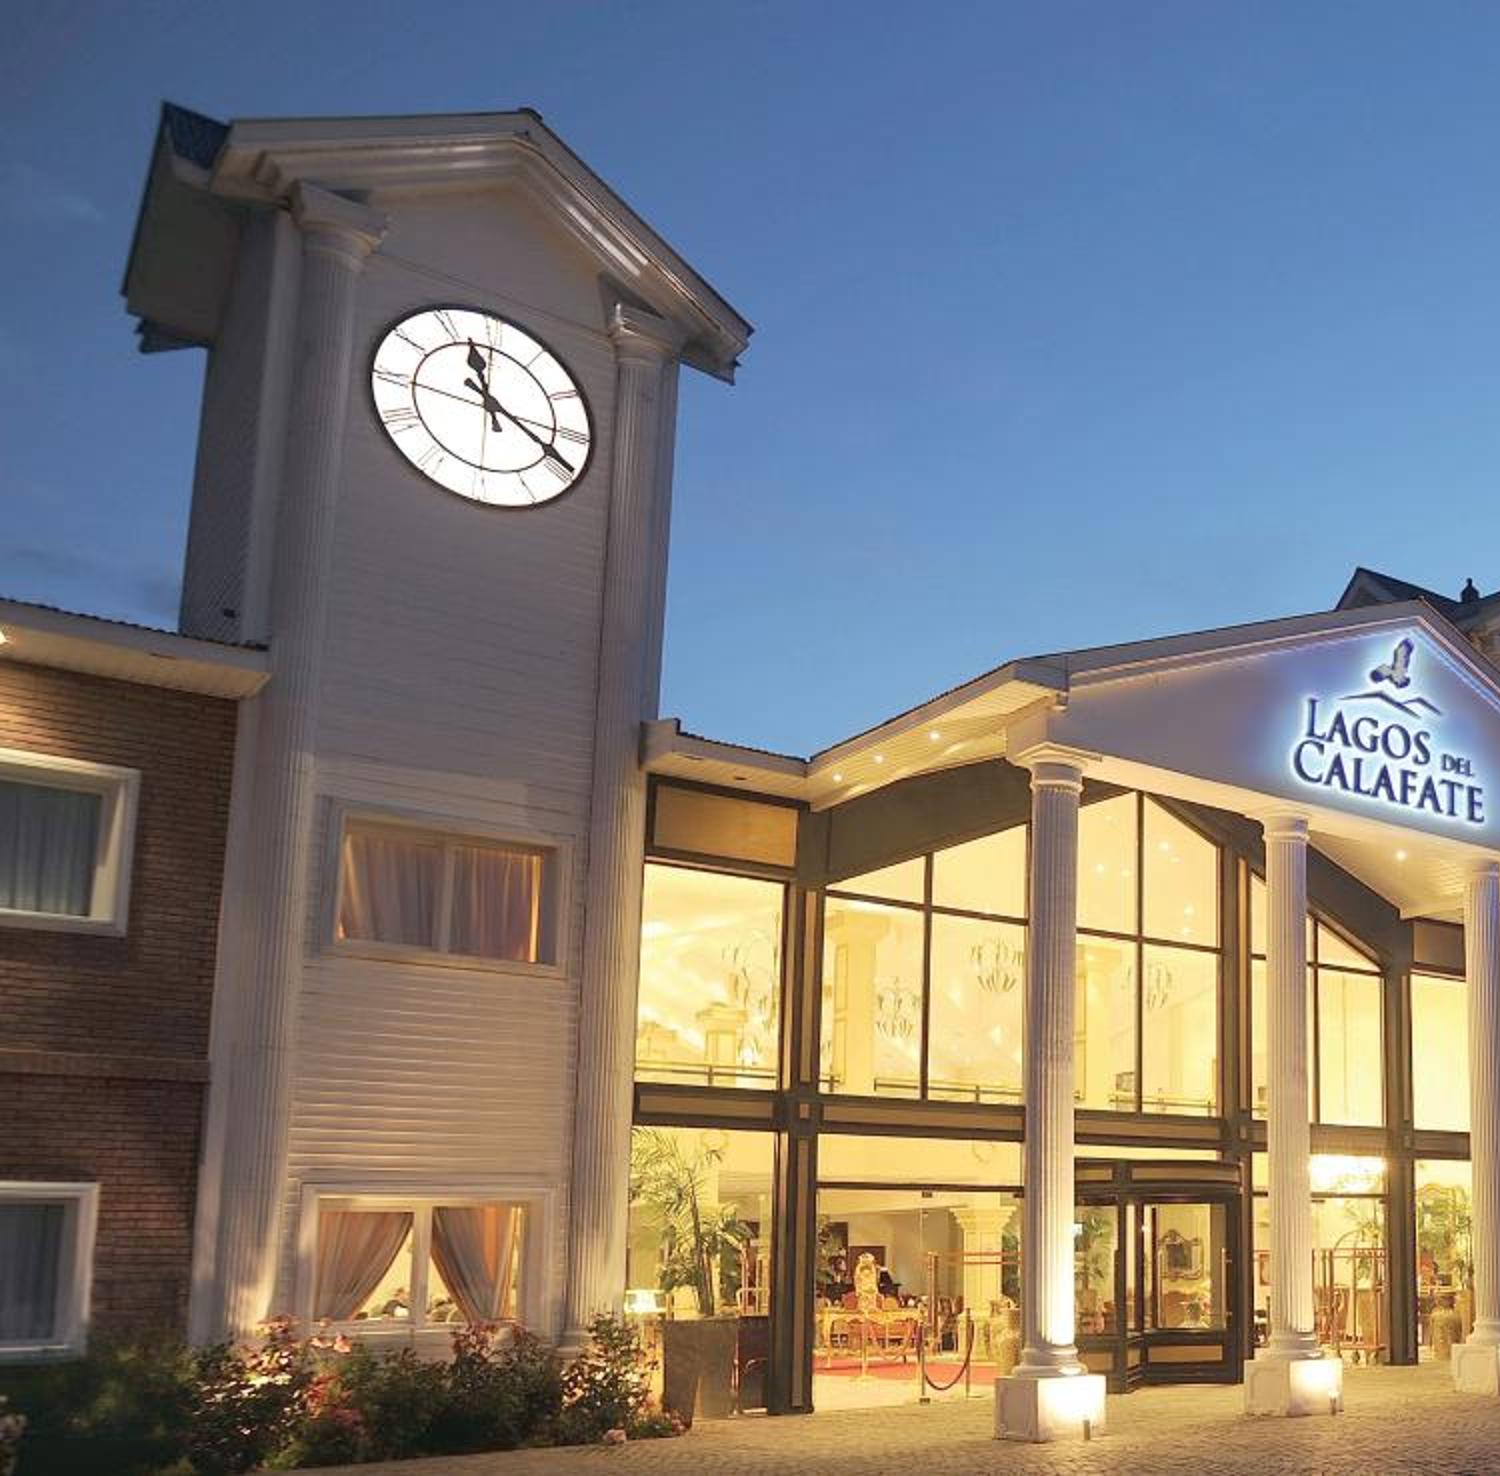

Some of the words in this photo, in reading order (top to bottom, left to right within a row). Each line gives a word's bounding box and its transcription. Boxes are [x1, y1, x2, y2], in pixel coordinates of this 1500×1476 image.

[1305, 698, 1431, 765] LAGOS
[1441, 754, 1475, 777] DEL
[1293, 739, 1486, 823] CALAFATE
